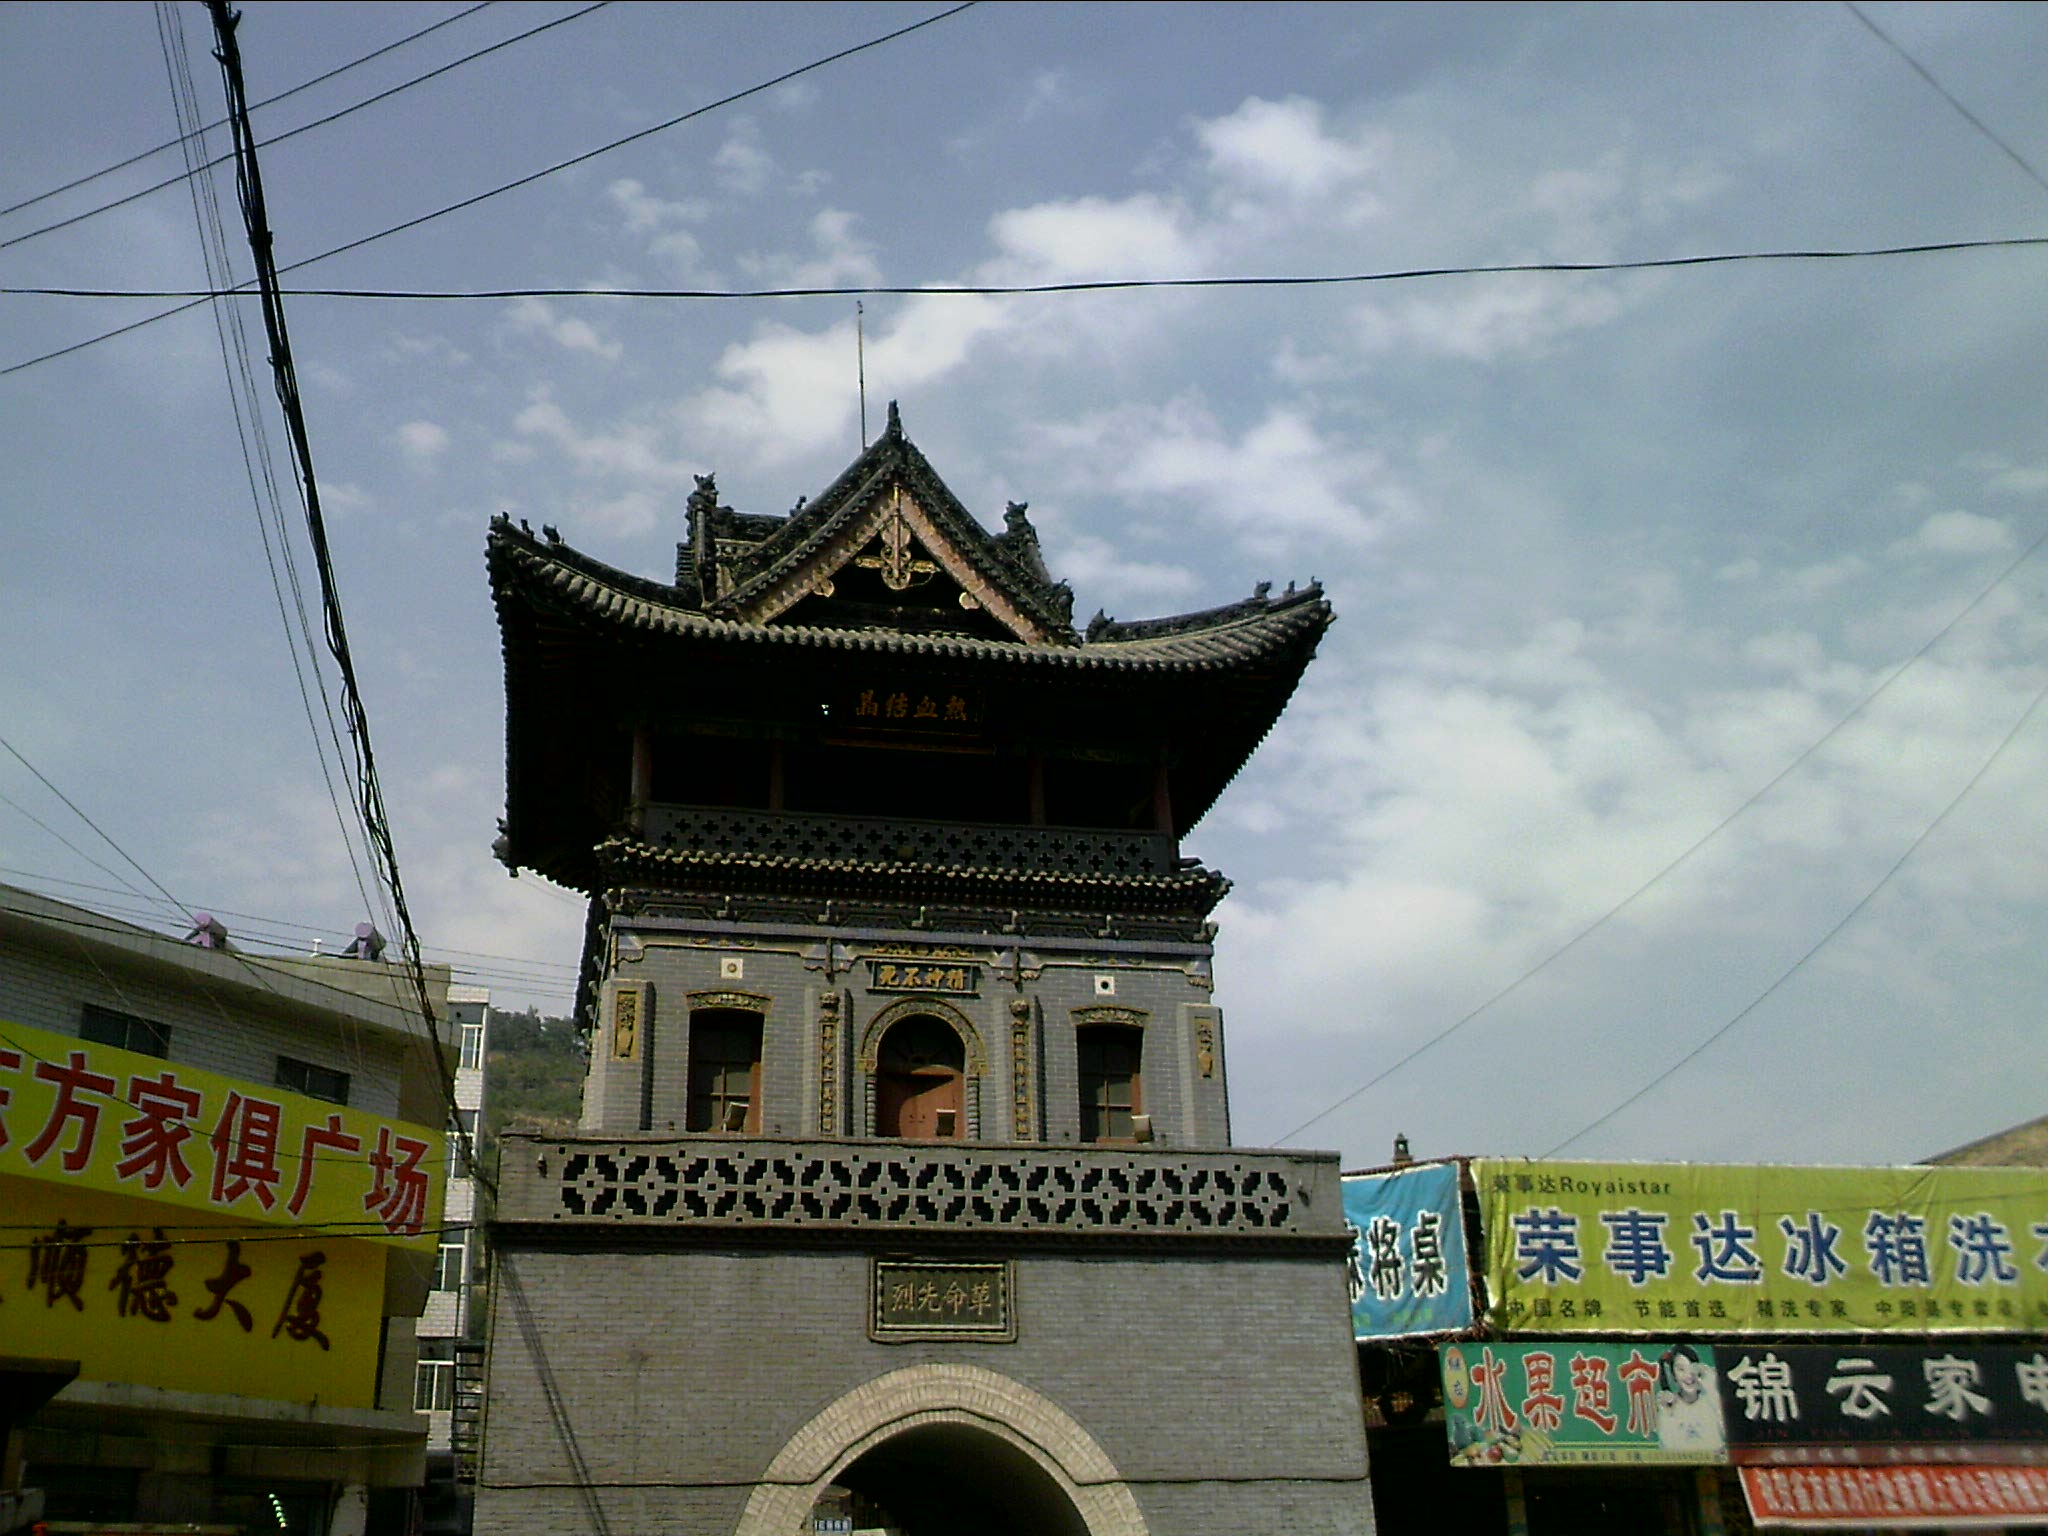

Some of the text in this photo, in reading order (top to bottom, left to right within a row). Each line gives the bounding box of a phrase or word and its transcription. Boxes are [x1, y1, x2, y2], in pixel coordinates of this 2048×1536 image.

[1506, 1298, 1603, 1319] 中国名牌
[1634, 1298, 1727, 1319] 节能首选
[1470, 1347, 1660, 1438] 水果超市
